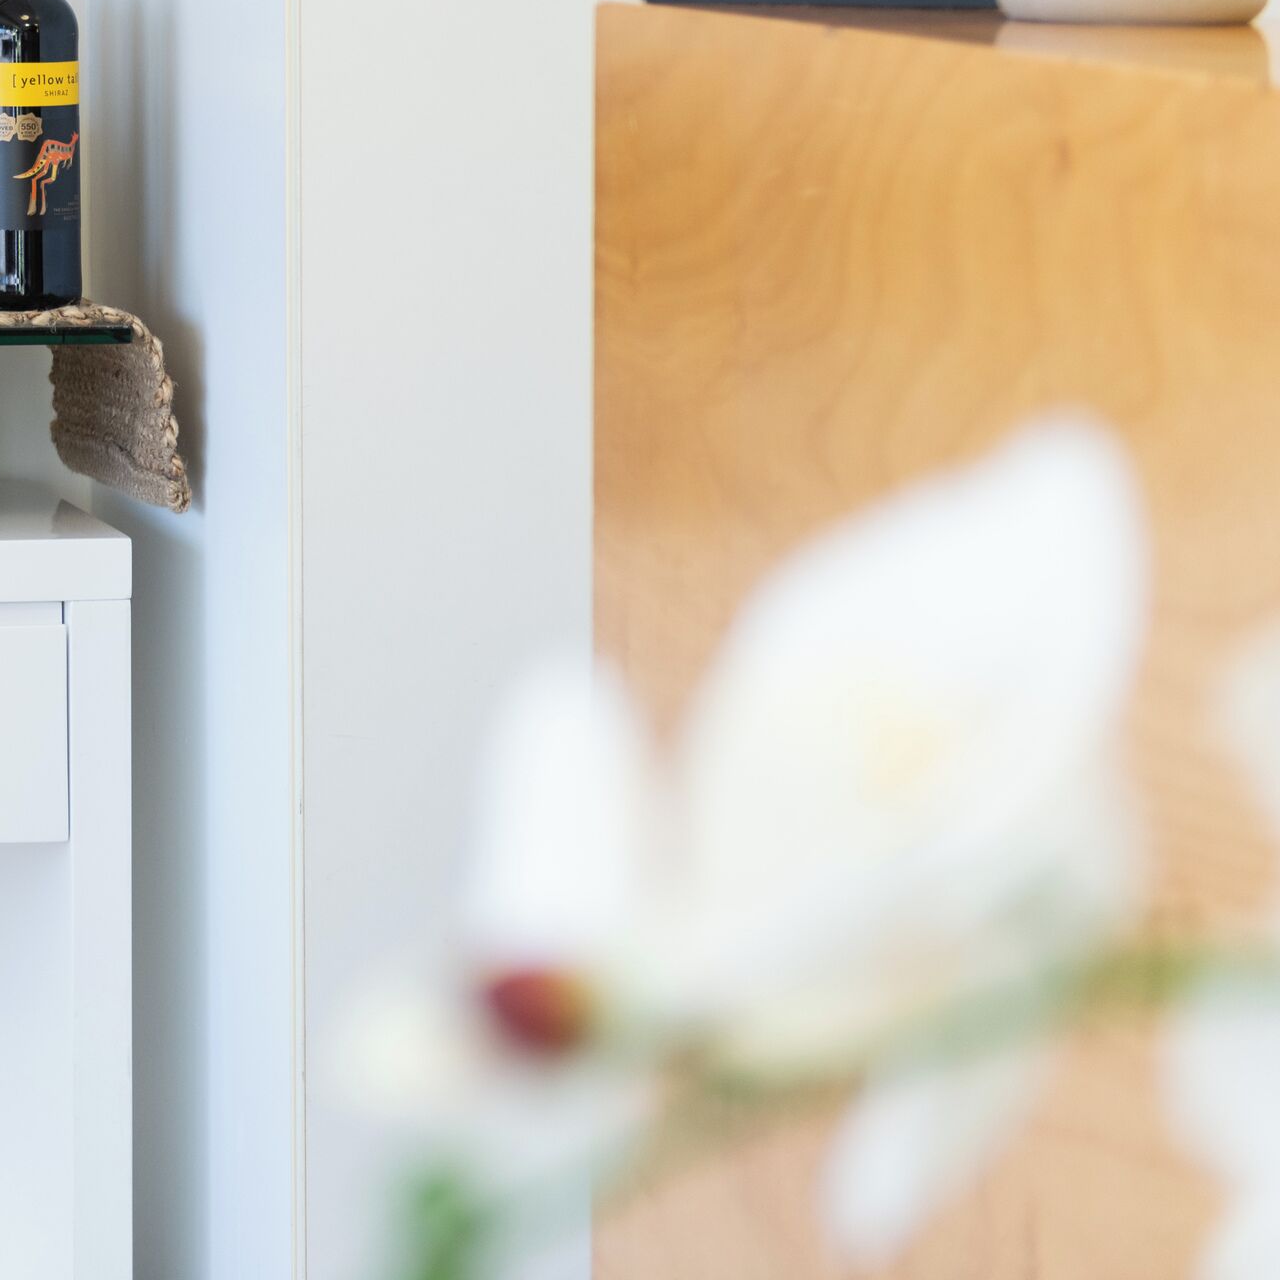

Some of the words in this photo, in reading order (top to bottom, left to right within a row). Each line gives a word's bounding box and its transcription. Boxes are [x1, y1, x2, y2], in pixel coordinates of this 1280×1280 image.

[21, 74, 64, 88] yellow
[44, 89, 68, 97] SHIRAZ
[21, 123, 36, 131] 550
